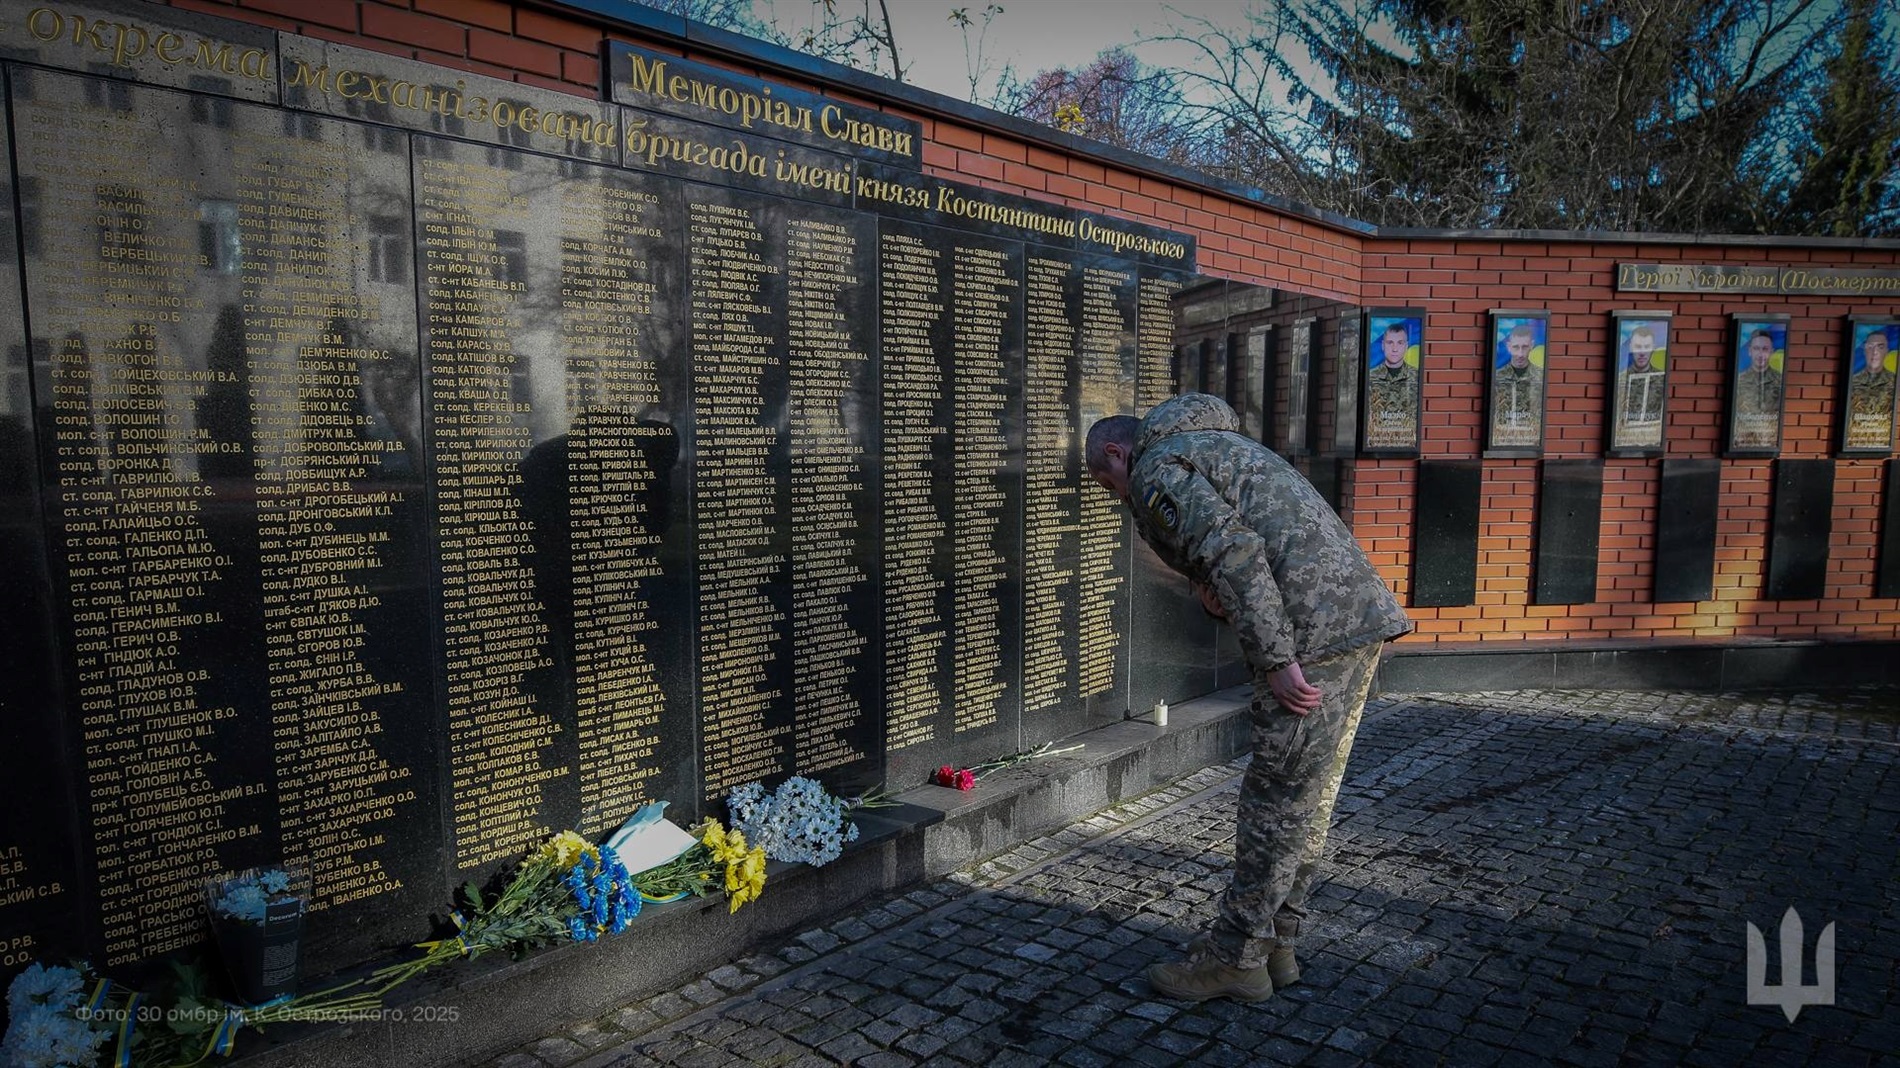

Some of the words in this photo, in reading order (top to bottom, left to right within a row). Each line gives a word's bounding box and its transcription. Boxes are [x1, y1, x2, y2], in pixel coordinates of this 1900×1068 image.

[628, 52, 813, 133] Меморіал
[821, 104, 912, 157] Слави
[27, 8, 272, 80] окрема
[288, 59, 617, 148] механізована
[627, 119, 767, 178] бригада
[775, 149, 851, 194] імені
[857, 175, 929, 208] князя
[936, 186, 1075, 237] Костянтина
[1078, 217, 1185, 260] Острозького
[427, 263, 445, 272] с-нт
[448, 261, 473, 274] ЙОРА
[561, 264, 582, 276] солд.
[1620, 266, 1682, 289] Герої
[1688, 268, 1777, 291] України
[434, 416, 457, 424] ст-на
[460, 414, 494, 424] КЕСЛЕР
[435, 429, 458, 437] солд.
[460, 426, 512, 436] КИРИЛЕНКО
[567, 440, 587, 448] солд.
[589, 438, 620, 447] КРАСЮК
[254, 470, 285, 482] солд.
[285, 468, 346, 481] ДОВБИЩУК
[348, 467, 366, 478] А.Р.
[436, 466, 460, 475] солд.
[462, 463, 502, 473] КИРЯЧОК
[438, 490, 461, 499] солд.
[463, 487, 491, 497] КІНАШ
[569, 497, 590, 505] солд.
[590, 493, 622, 504] КРЮЧКО
[65, 522, 99, 532] солд.
[102, 515, 171, 530] ГАЛАЙЦЬО
[174, 514, 198, 526] О.С.
[258, 526, 287, 536] солд.
[288, 523, 311, 536] ДУБ
[313, 522, 336, 532] О.Ф.
[570, 531, 590, 539] солд.
[592, 526, 631, 537] КУЗНЕЦОВ
[441, 564, 465, 573] солд.
[466, 559, 502, 570] КОВАЛЬ
[73, 611, 108, 622] солд.
[110, 604, 151, 618] ГЕНИЧ
[155, 602, 180, 614] В.М.
[264, 604, 314, 617] штаб-с-нт
[318, 598, 356, 613] Д'ЯКОВ
[358, 596, 381, 609] Д.Ю.
[77, 656, 96, 667] к-н
[104, 647, 152, 663] ГІНДЮК
[155, 645, 179, 657] А.О.
[269, 673, 297, 684] солд.
[299, 664, 343, 680] ЖИГАЛО
[345, 662, 365, 674] П.В.
[448, 695, 472, 705] солд.
[473, 688, 500, 701] КОЗУН
[578, 740, 598, 749] солд.
[599, 732, 624, 745] ЛИСАК
[275, 752, 296, 763] с-нт
[299, 741, 349, 759] ЗАРЕМБА
[351, 738, 370, 749] С.А.
[89, 771, 122, 783] солд.
[124, 756, 190, 777] ГОЙДЕНКО
[193, 752, 216, 764] С.А.
[452, 766, 475, 776] солд.
[476, 753, 522, 771] КОЛПАКОВ
[92, 800, 117, 813] пр-к
[122, 785, 187, 806] ГОЛУБЕЦЬ
[190, 780, 213, 792] Є.О.
[581, 793, 600, 803] солд.
[601, 784, 632, 798] ЛОБАНЬ
[98, 870, 123, 883] с-нт
[127, 851, 193, 876] ГОРБАТЮК
[196, 847, 217, 860] Р.О.
[38, 881, 65, 897] С.В.
[12, 935, 37, 950] Р.В.
[4, 950, 33, 967] О.О.
